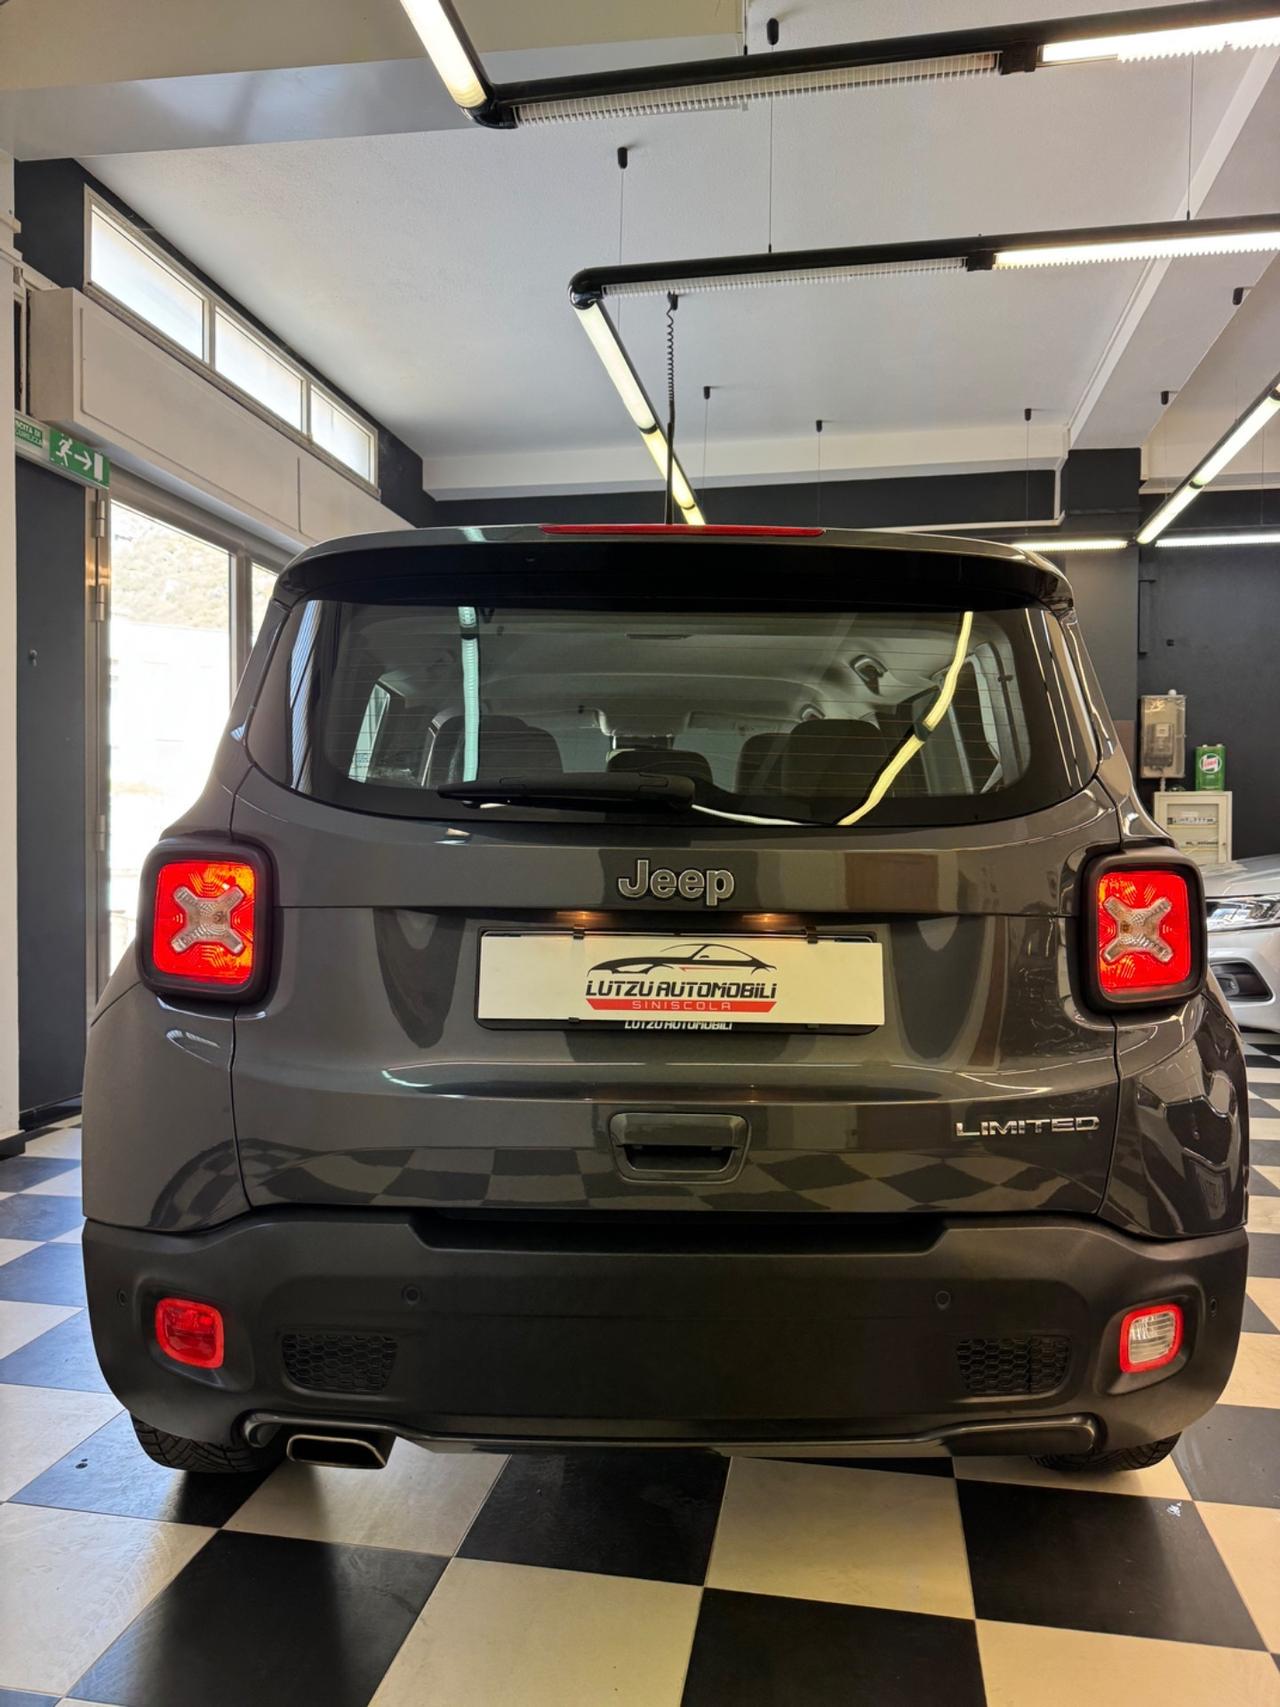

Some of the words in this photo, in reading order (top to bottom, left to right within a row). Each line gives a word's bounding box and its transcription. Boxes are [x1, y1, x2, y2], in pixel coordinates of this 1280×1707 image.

[618, 859, 735, 906] Jeep
[585, 980, 653, 997] LUTZU
[656, 981, 777, 999] AUTOMOBILI
[632, 1000, 731, 1010] SINISCOLA
[624, 1020, 663, 1029] LUTZU
[956, 1116, 1100, 1136] LIMITED
